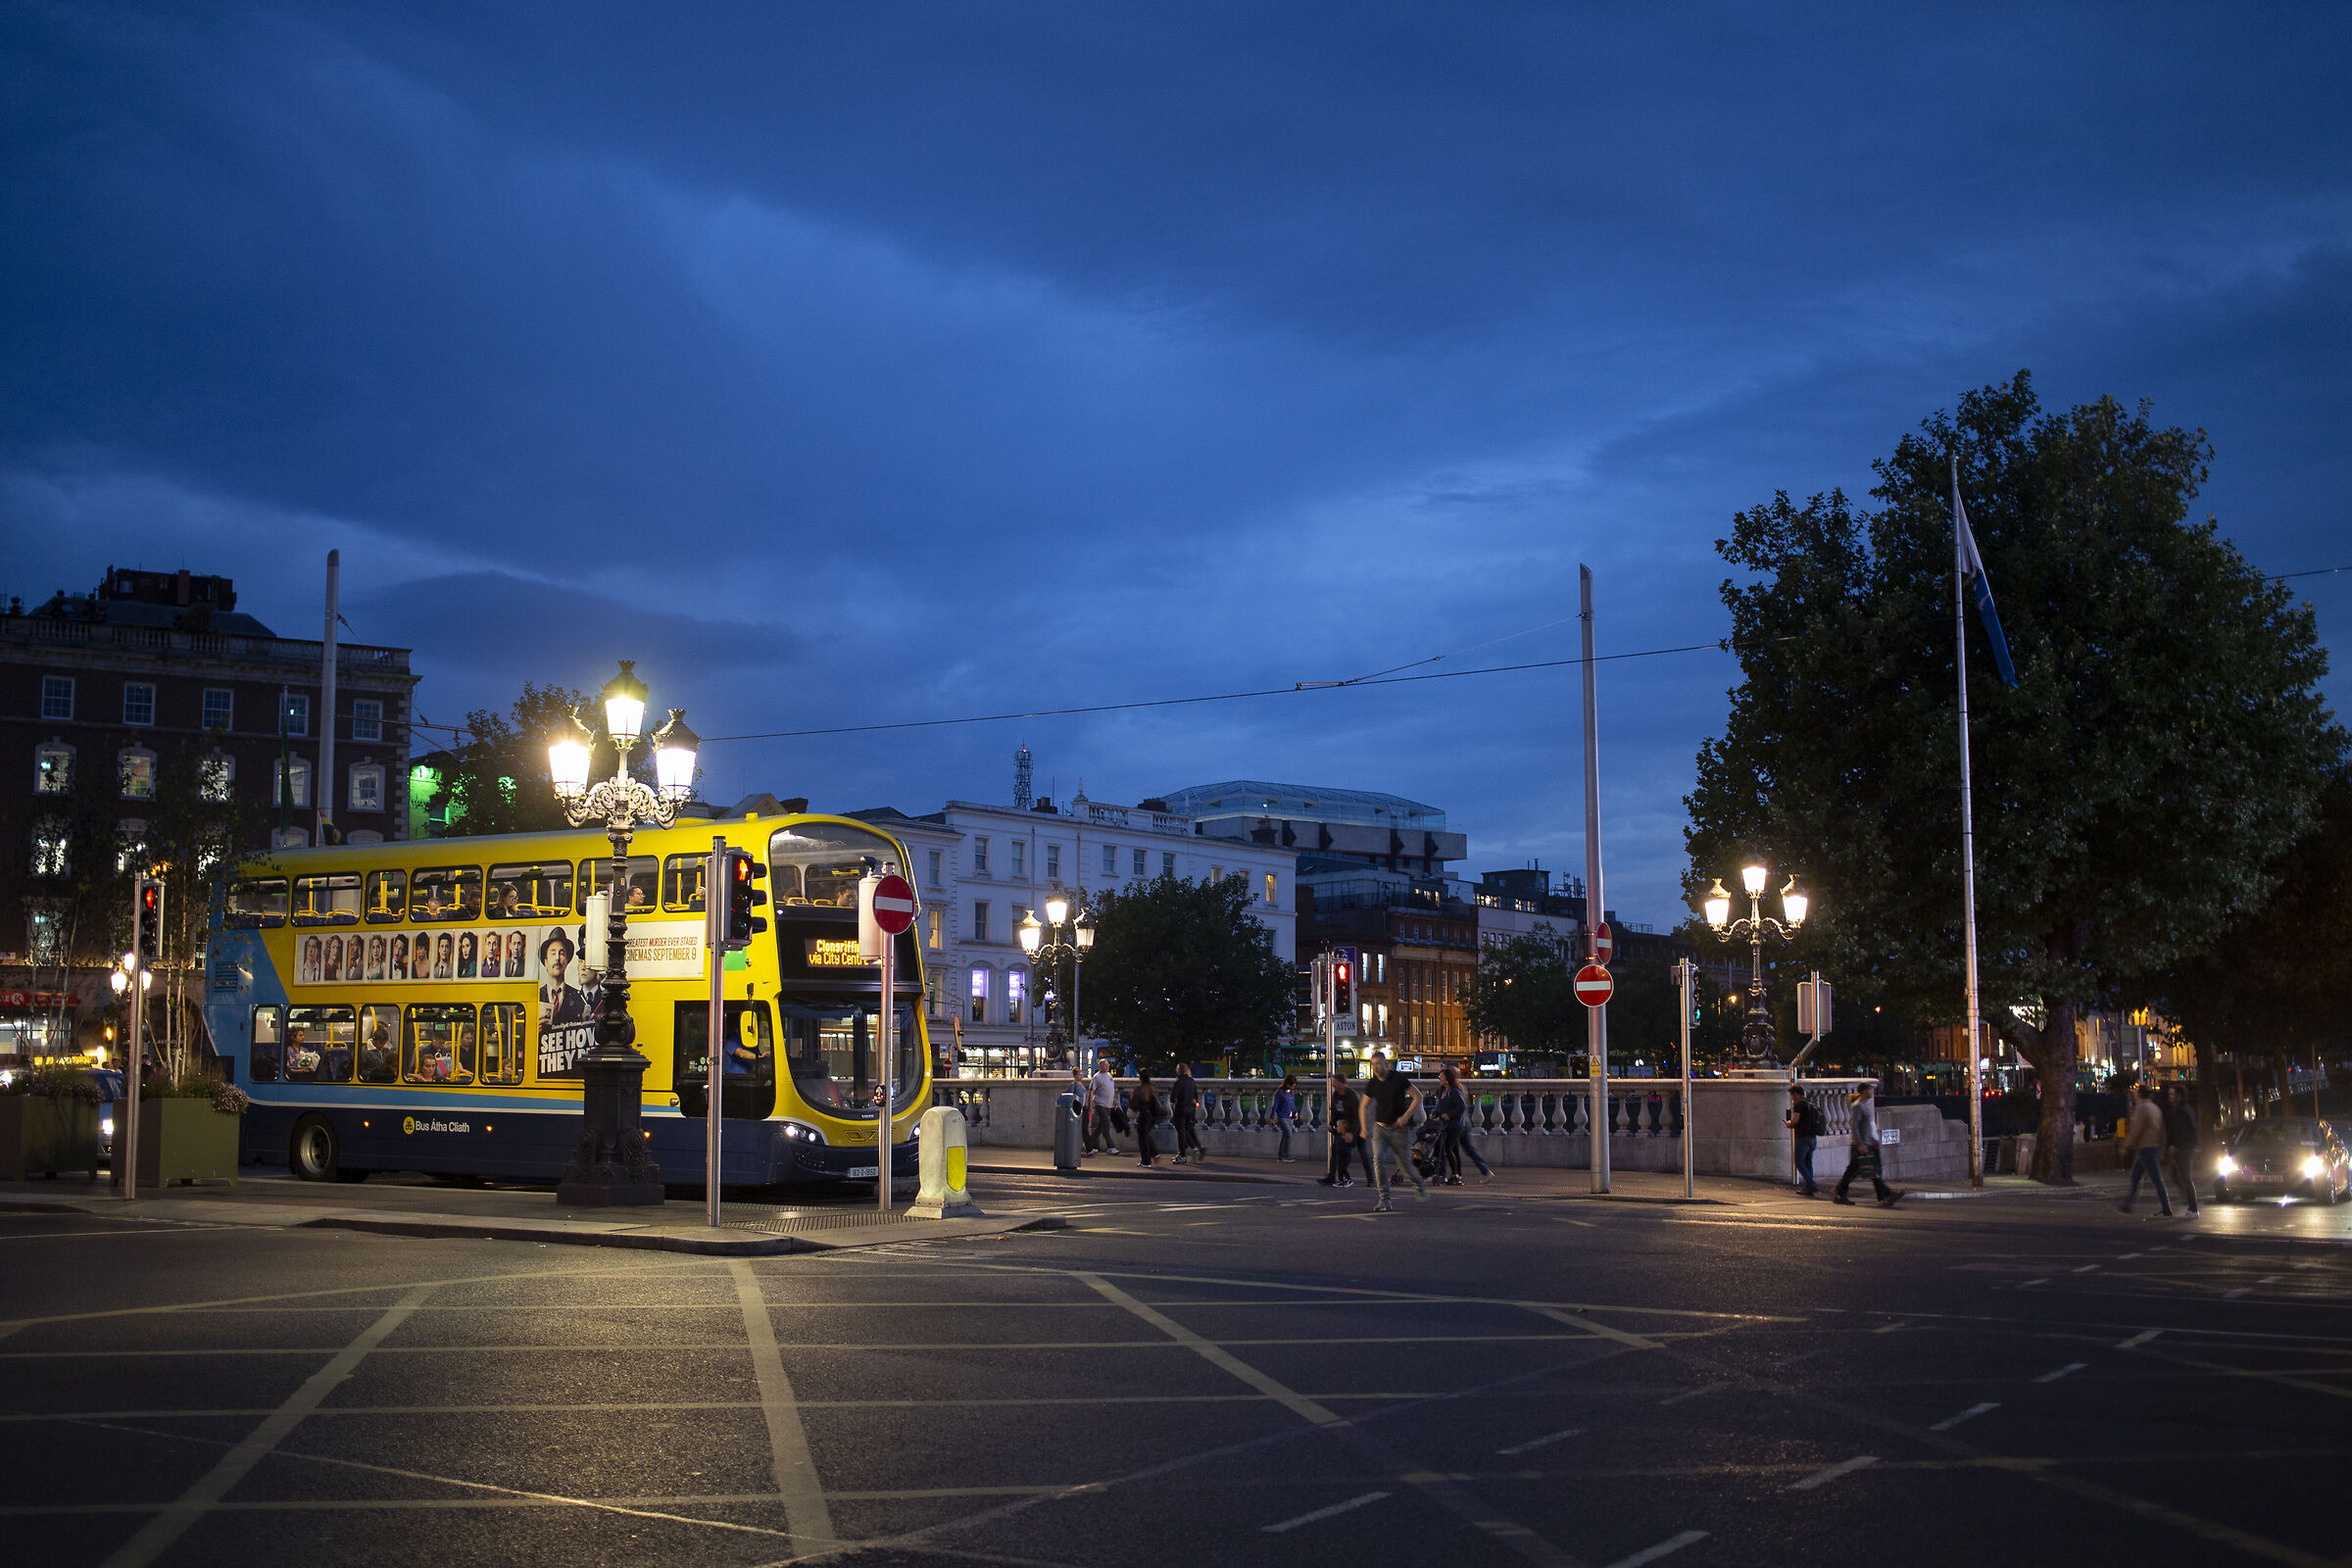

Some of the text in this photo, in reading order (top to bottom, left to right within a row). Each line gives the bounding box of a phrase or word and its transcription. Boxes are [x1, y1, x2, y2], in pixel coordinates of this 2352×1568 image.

[649, 937, 667, 947] MURDER
[667, 937, 679, 946] EVER
[680, 936, 698, 946] STAGED
[625, 947, 697, 961] CINEMAS SEPTEMBER 9
[808, 952, 822, 965] via
[823, 953, 841, 965] City
[1336, 1020, 1355, 1031] ASTON
[540, 1031, 564, 1054] SEE
[539, 1049, 575, 1074] THEY
[415, 1117, 469, 1133] Bus Átha Cliath
